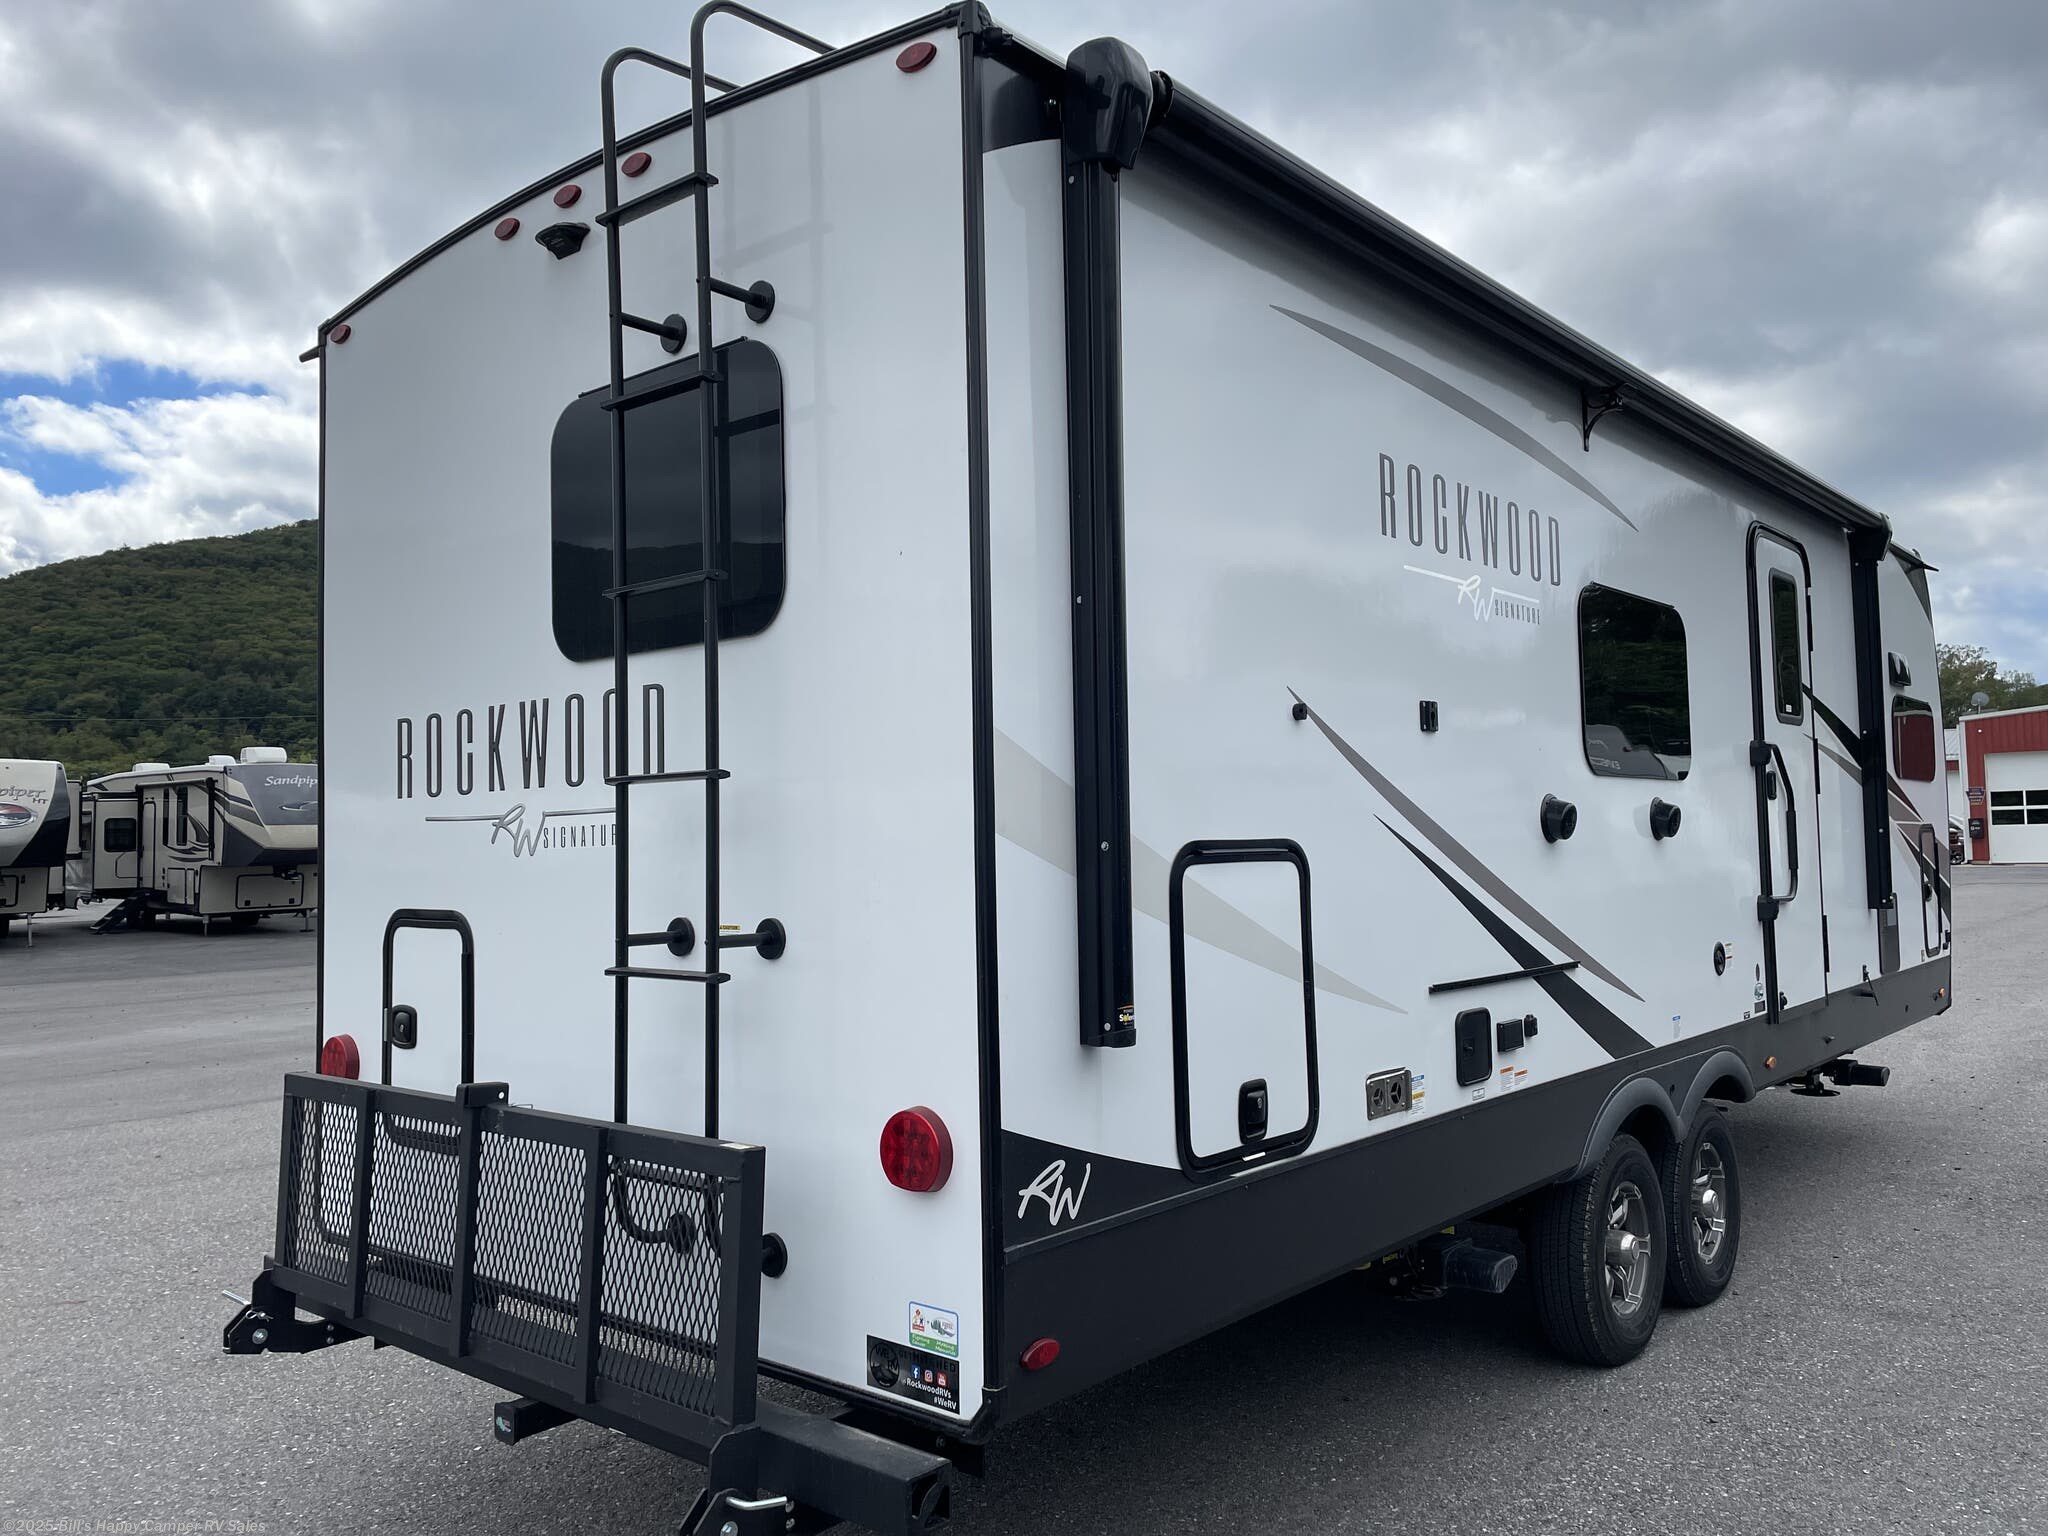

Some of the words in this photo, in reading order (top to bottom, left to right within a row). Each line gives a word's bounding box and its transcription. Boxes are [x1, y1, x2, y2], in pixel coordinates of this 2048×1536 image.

[1379, 453, 1561, 586] ROCKWOOD
[1495, 600, 1540, 625] SIGNATURE
[264, 774, 318, 788] Sandpip
[0, 785, 46, 801] piper
[543, 823, 617, 849] SIGNATUR
[902, 1378, 952, 1399] @RockwoodRVs
[934, 1397, 957, 1410] #WeRV
